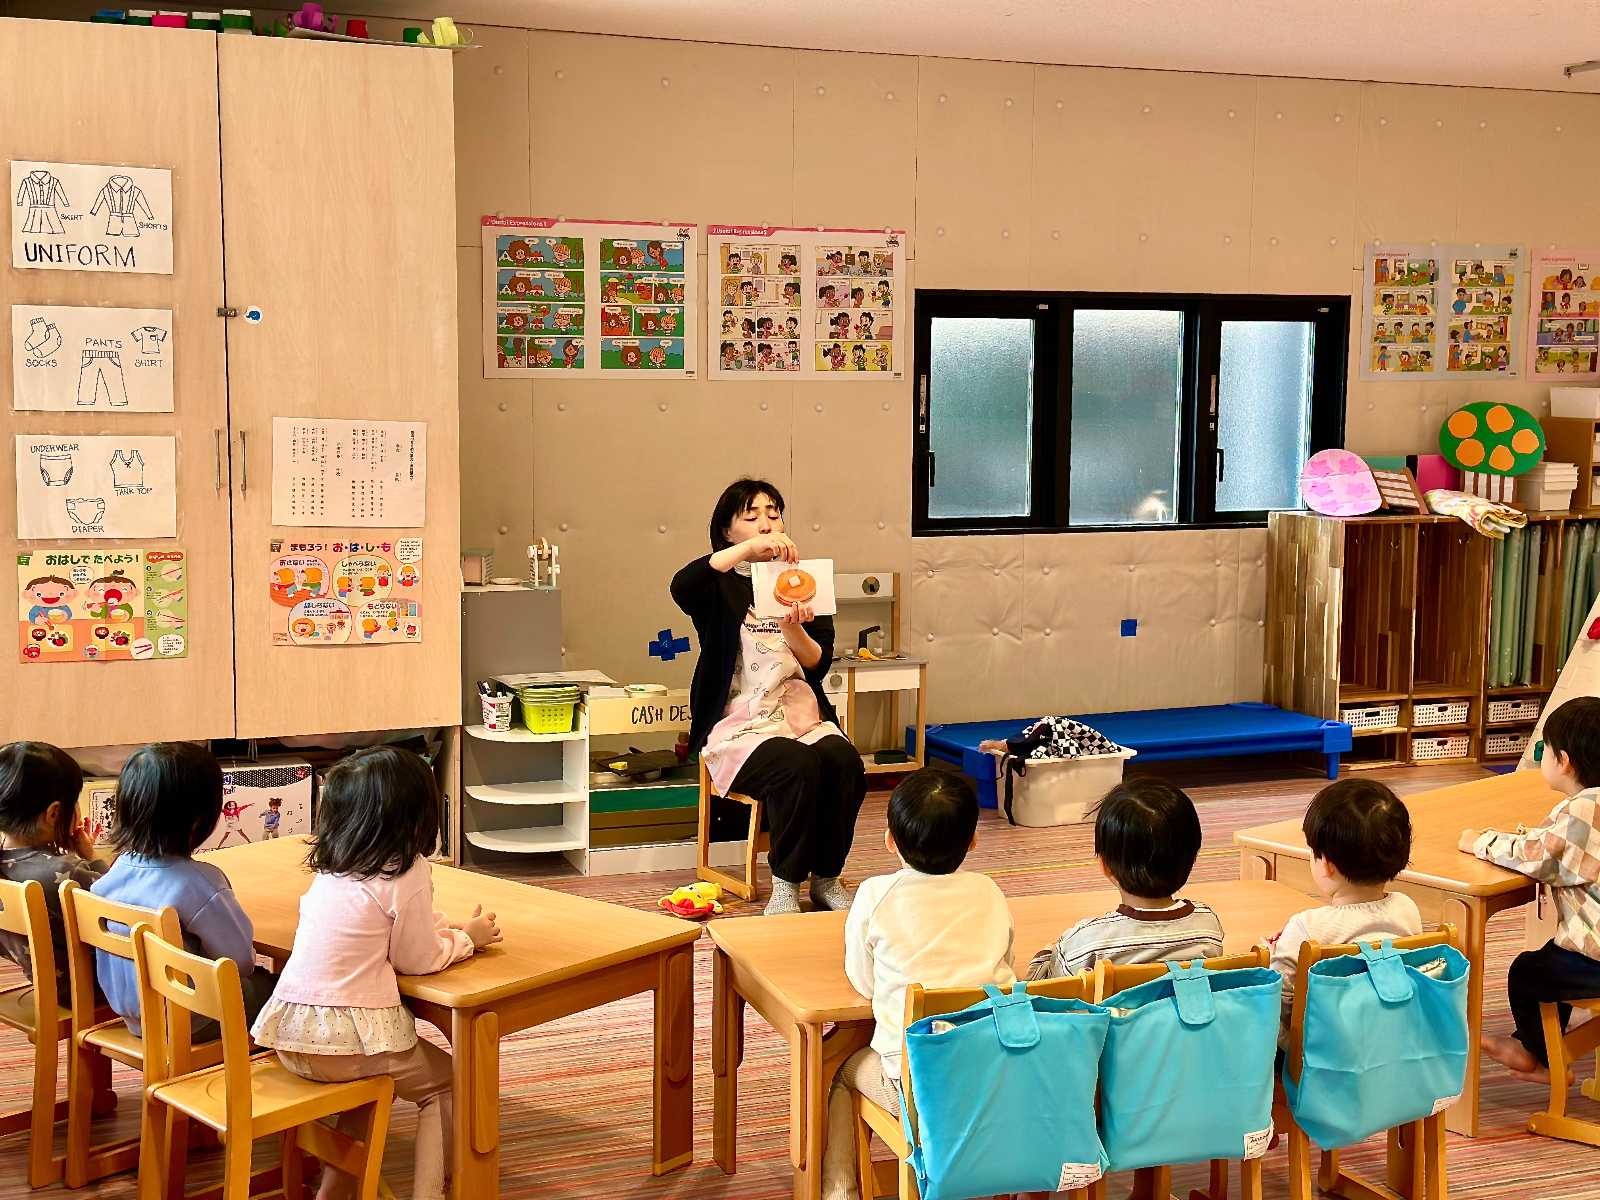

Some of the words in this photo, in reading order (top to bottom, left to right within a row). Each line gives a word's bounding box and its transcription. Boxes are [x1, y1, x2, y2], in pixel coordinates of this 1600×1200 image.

[24, 242, 136, 268] UNIFORM
[85, 337, 122, 349] PANTS
[25, 358, 58, 368] SOCKS
[134, 358, 164, 368] SHIRT
[30, 443, 79, 454] UNDERWEAR
[71, 525, 105, 533] DIAPER
[46, 554, 91, 566] おはしで
[631, 705, 664, 725] CASH
[669, 704, 693, 721] DE
